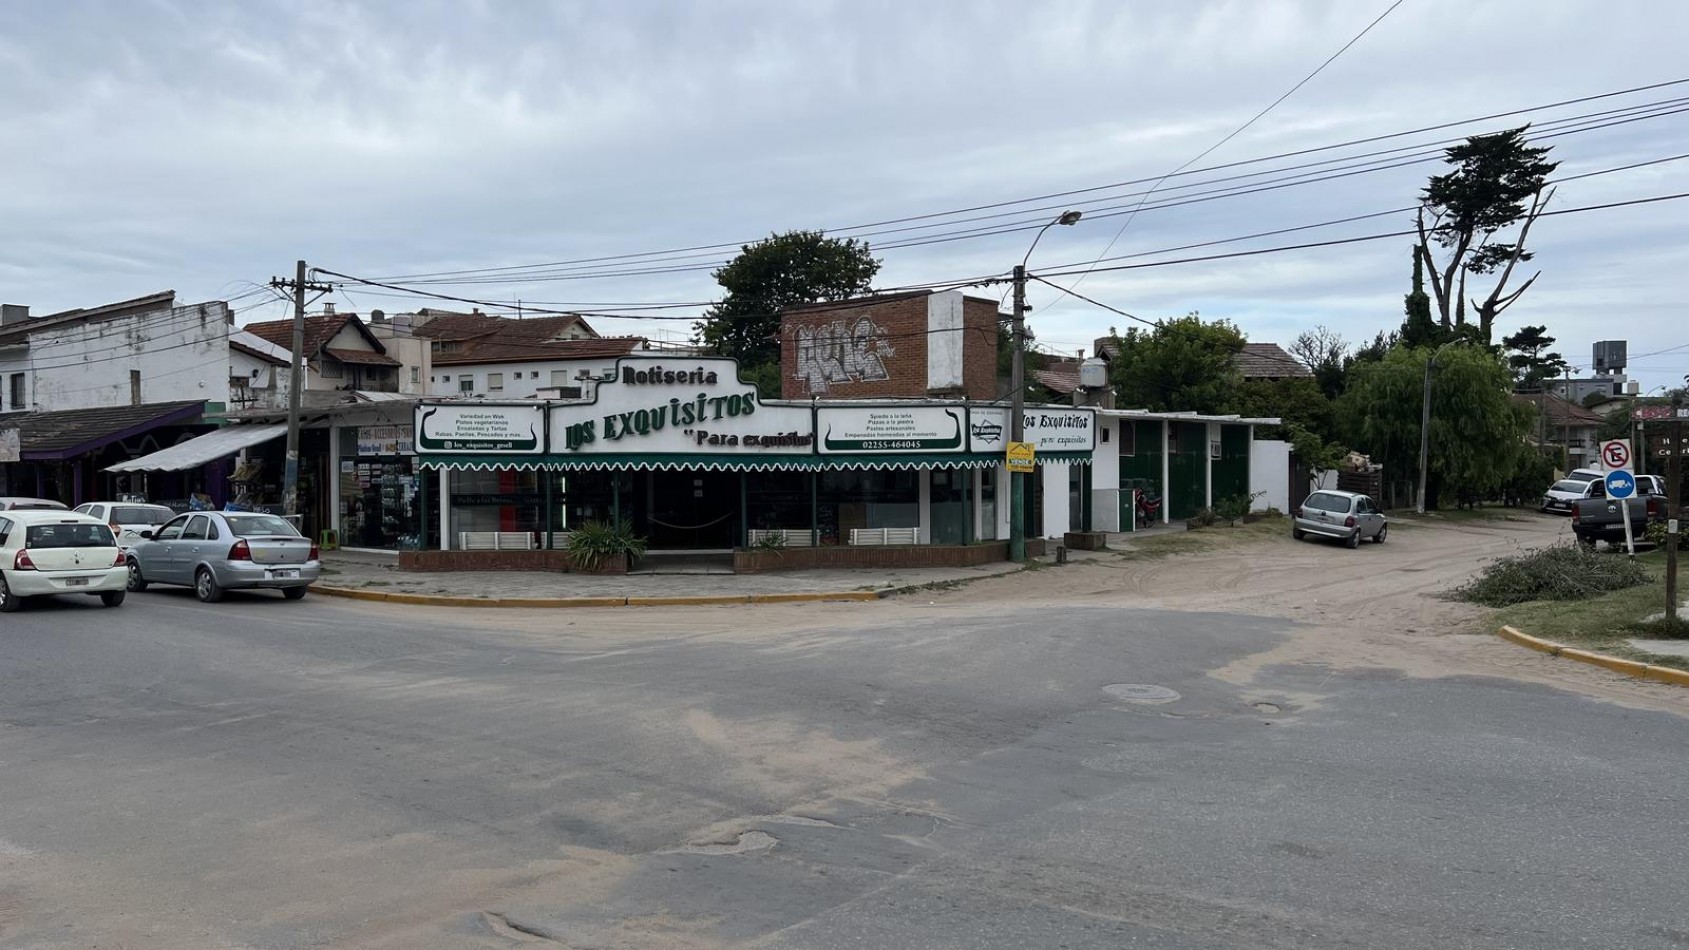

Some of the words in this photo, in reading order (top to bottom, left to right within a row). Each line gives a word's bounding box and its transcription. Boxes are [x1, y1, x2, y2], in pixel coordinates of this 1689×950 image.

[622, 365, 718, 385] Rotiseria
[862, 441, 921, 449] 02255-464045
[1057, 436, 1087, 447] exquisitos
